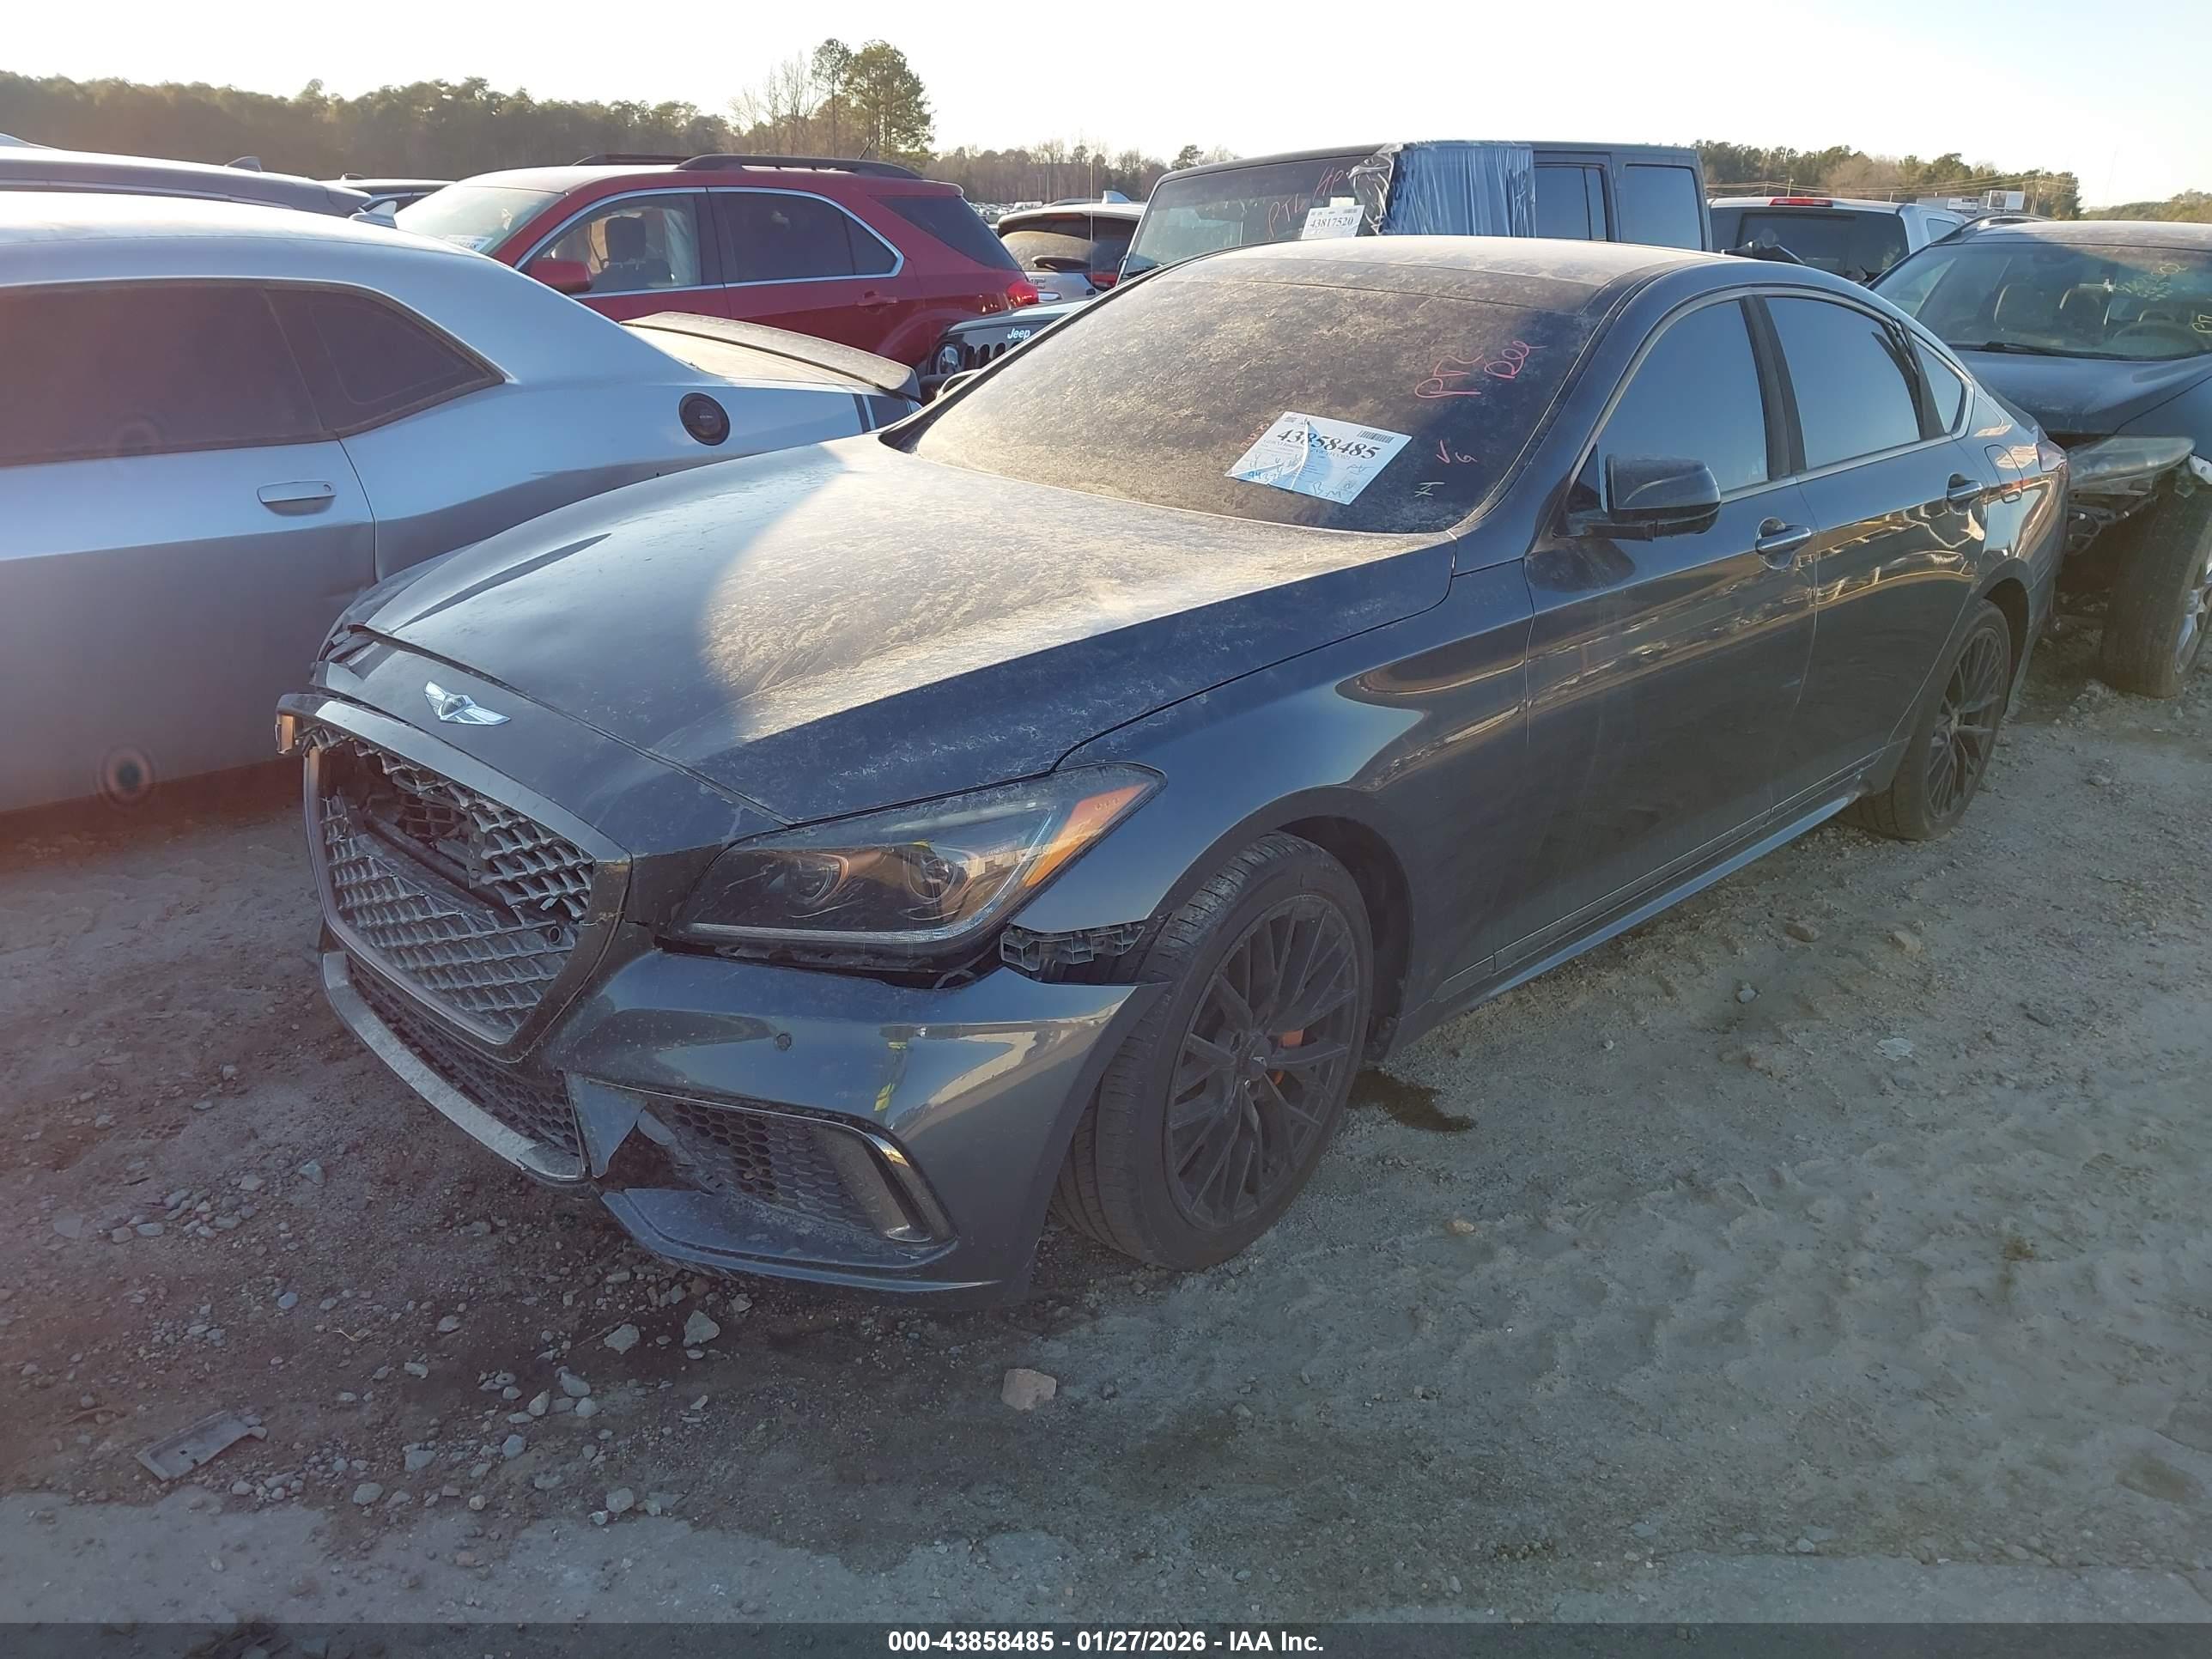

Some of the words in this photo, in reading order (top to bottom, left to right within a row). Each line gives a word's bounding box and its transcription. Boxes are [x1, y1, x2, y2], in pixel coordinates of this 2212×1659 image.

[1310, 216, 1354, 228] 43817520
[1007, 328, 1030, 339] Jeep
[1277, 429, 1381, 459] 43858485
